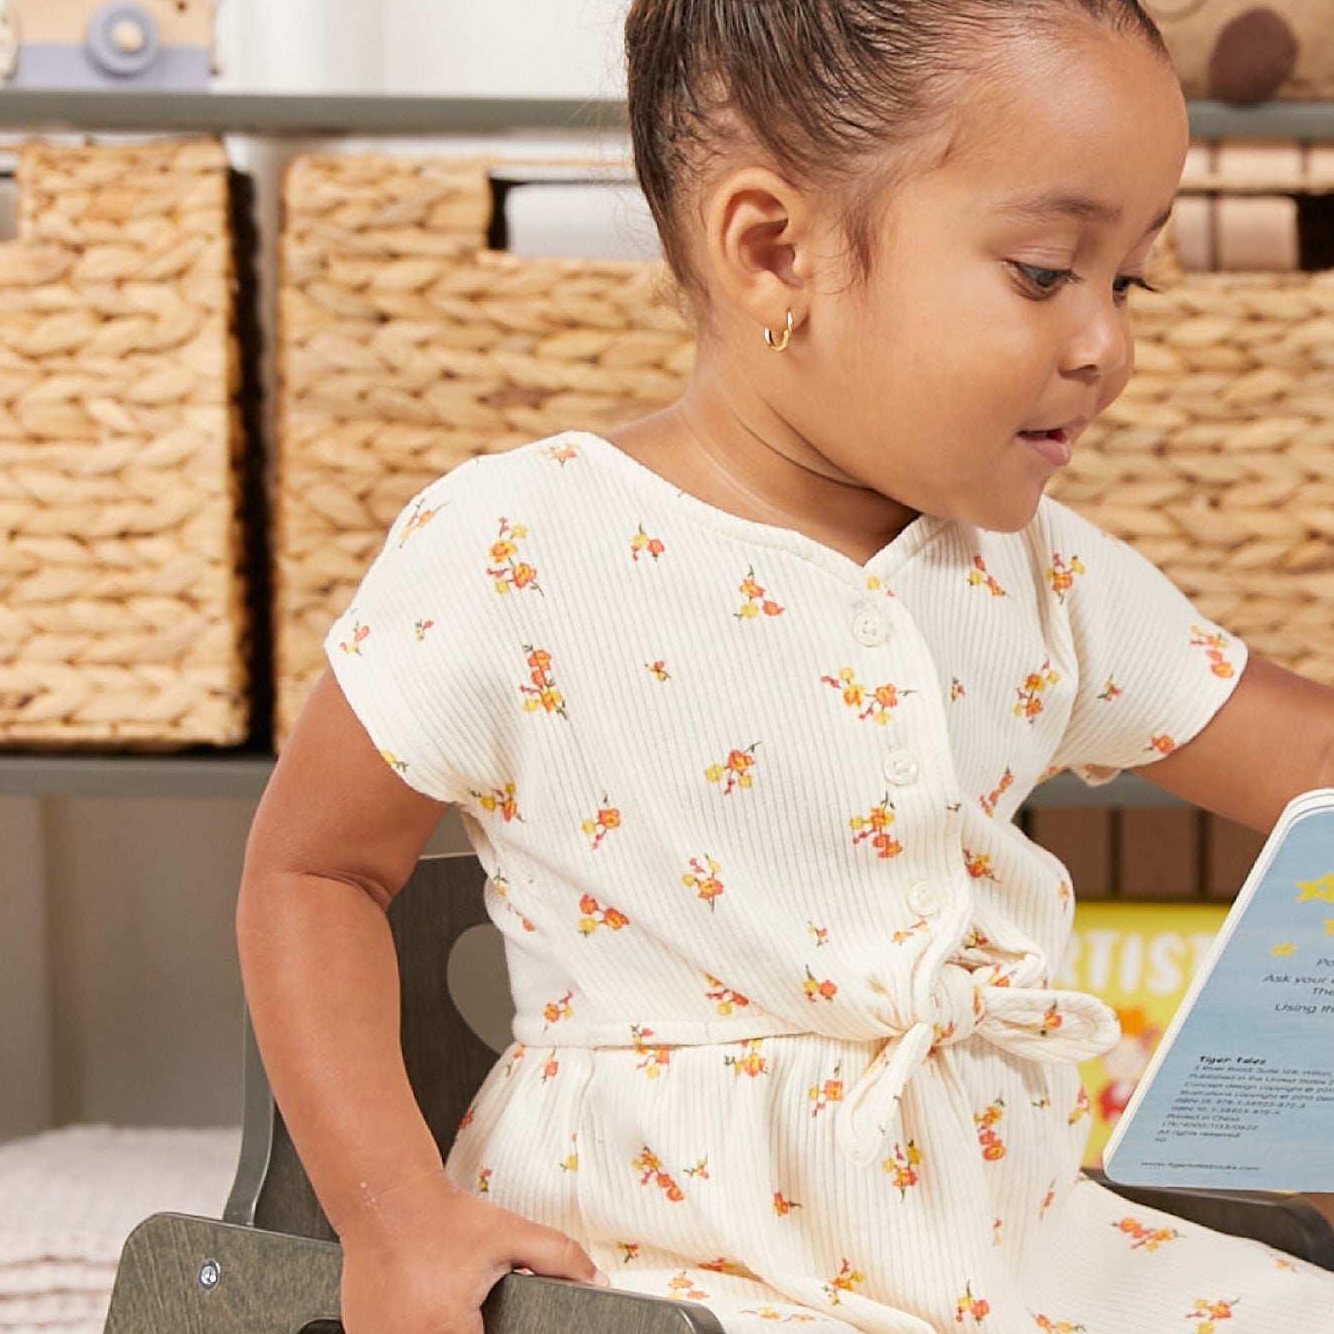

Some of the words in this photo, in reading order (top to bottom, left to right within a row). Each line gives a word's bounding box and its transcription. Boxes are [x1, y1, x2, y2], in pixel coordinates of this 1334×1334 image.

[1262, 973, 1291, 983] Ask
[1294, 976, 1327, 985] your
[1274, 1003, 1317, 1014] Using
